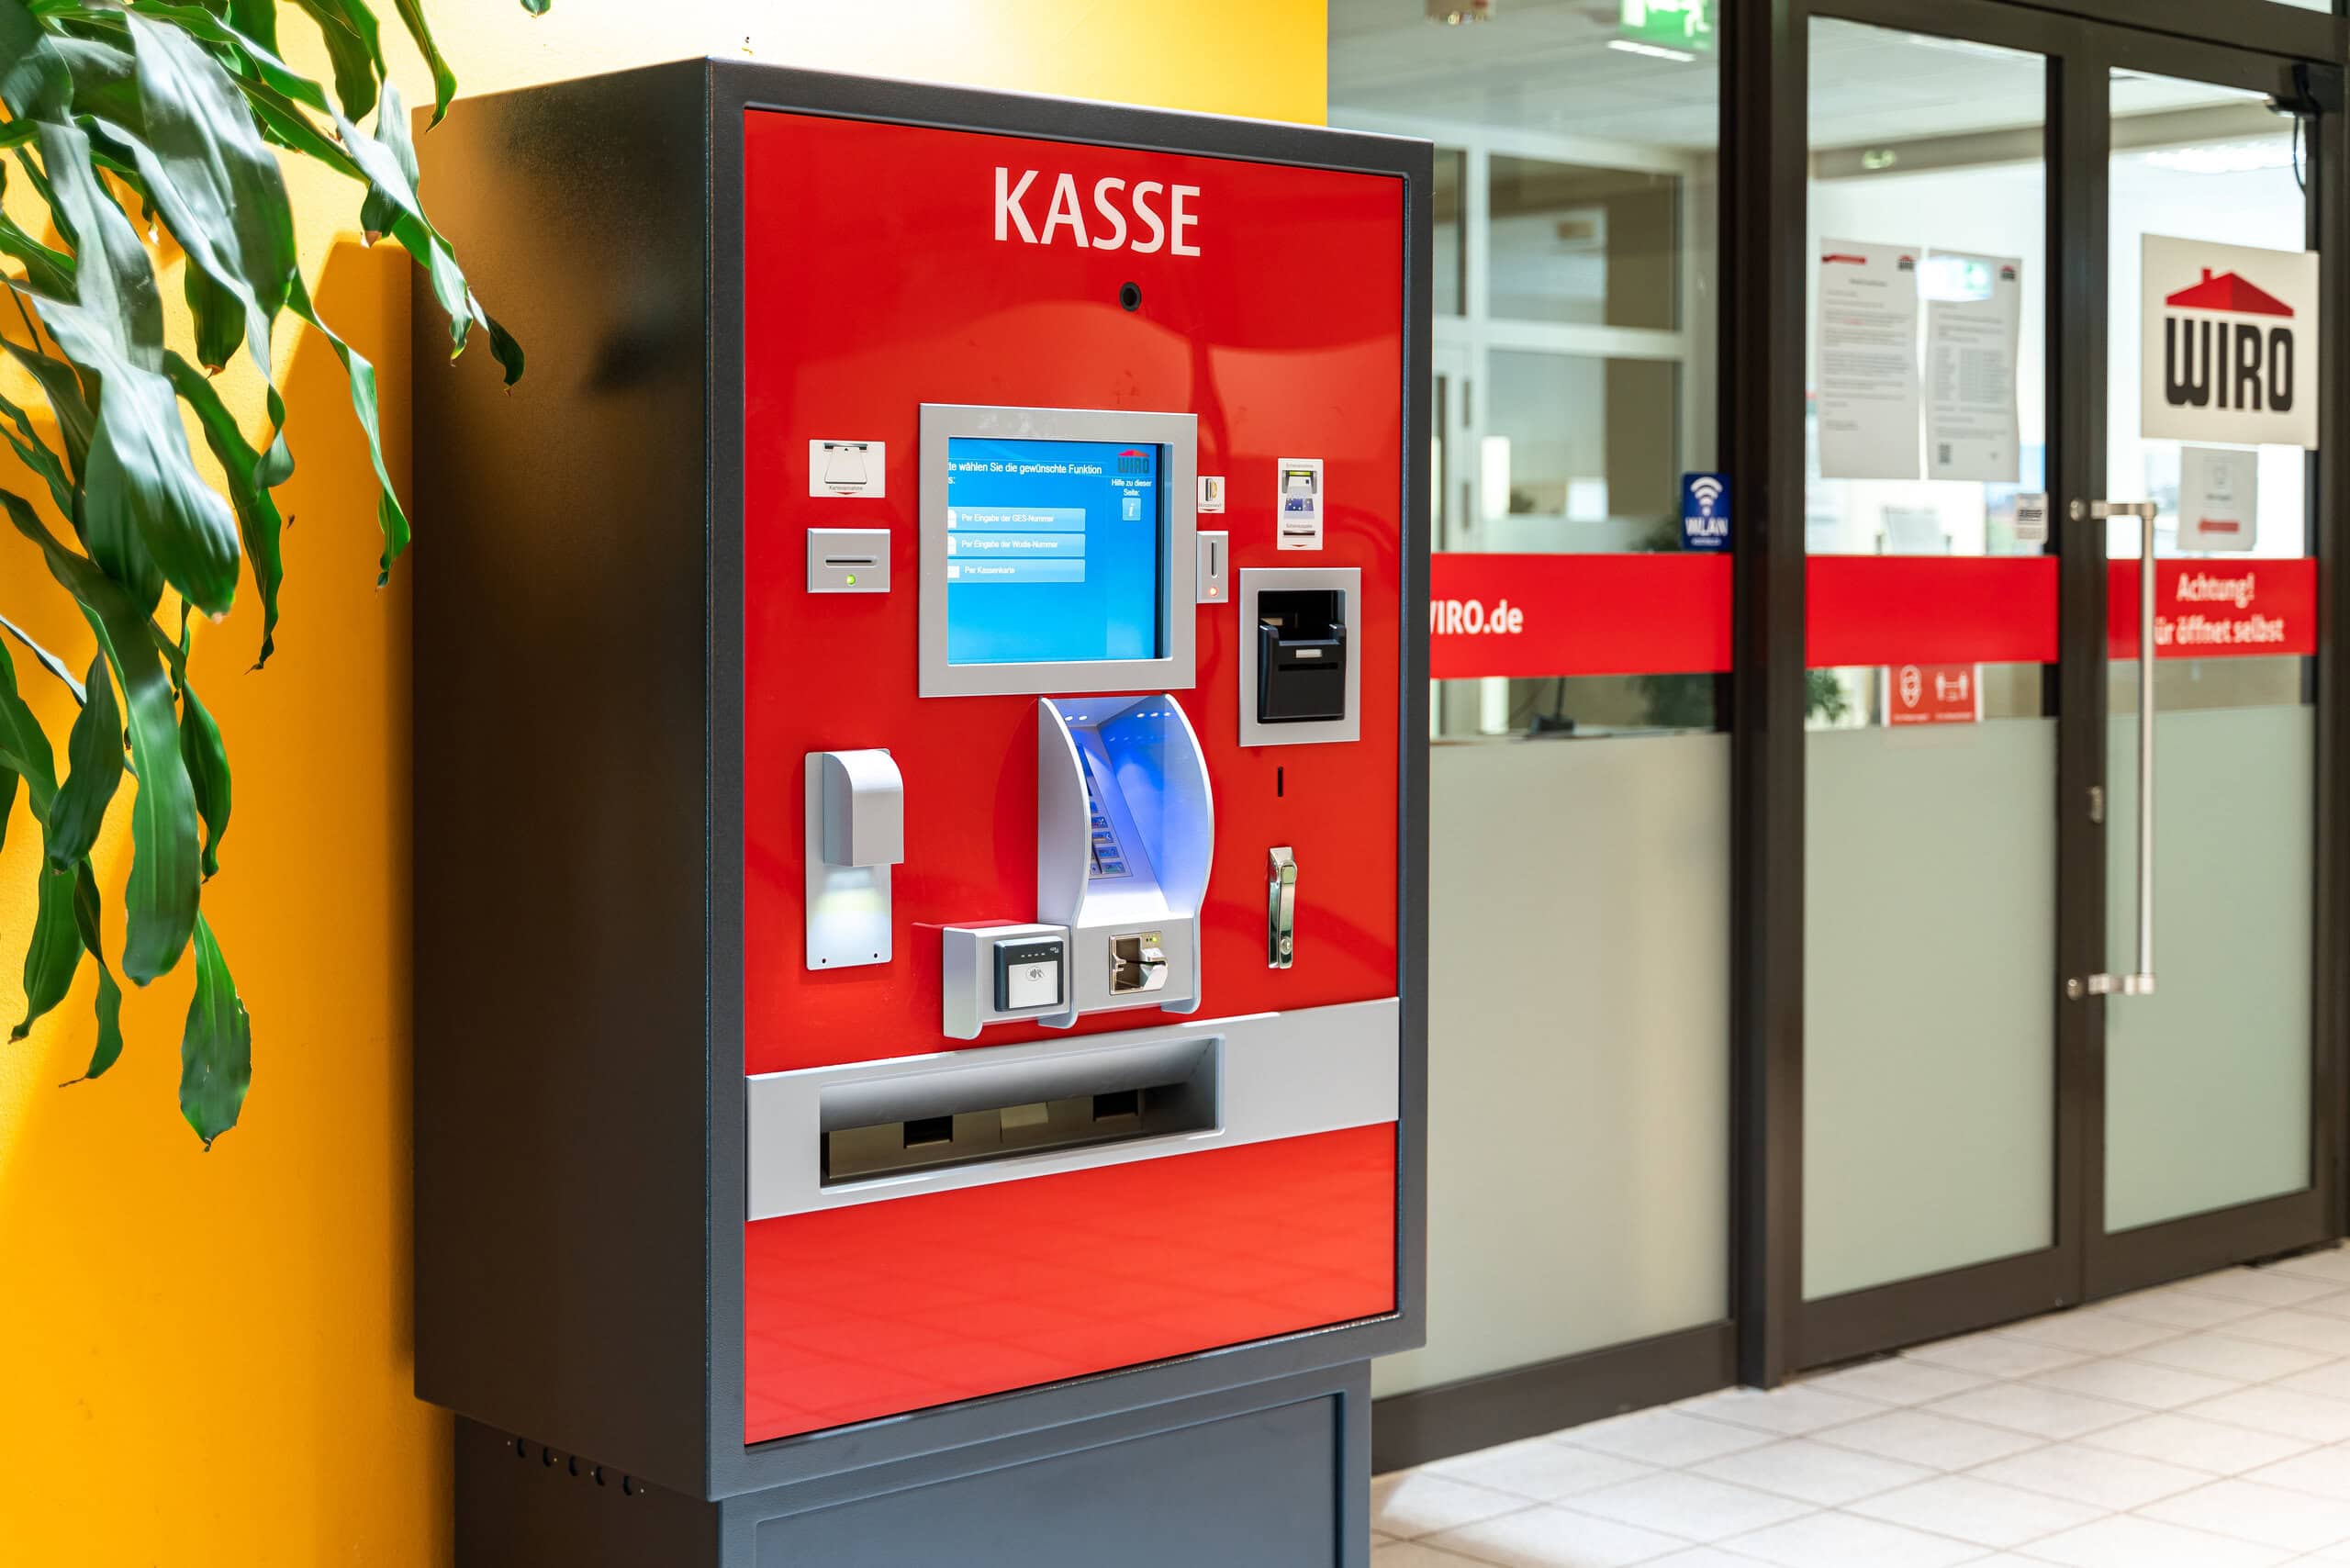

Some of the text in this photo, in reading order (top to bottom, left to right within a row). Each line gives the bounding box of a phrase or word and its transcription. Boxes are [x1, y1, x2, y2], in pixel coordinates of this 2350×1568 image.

[994, 166, 1201, 257] KASSE
[2165, 317, 2295, 412] WIRO
[959, 462, 989, 472] wählen
[990, 463, 1003, 472] Sie
[1005, 463, 1017, 473] die
[1020, 464, 1067, 475] gewünschte
[1069, 464, 1102, 475] Funktion
[1685, 517, 1729, 537] WLAN
[2176, 571, 2255, 610] Achtung!
[2154, 613, 2285, 645] ür öffnet selbst
